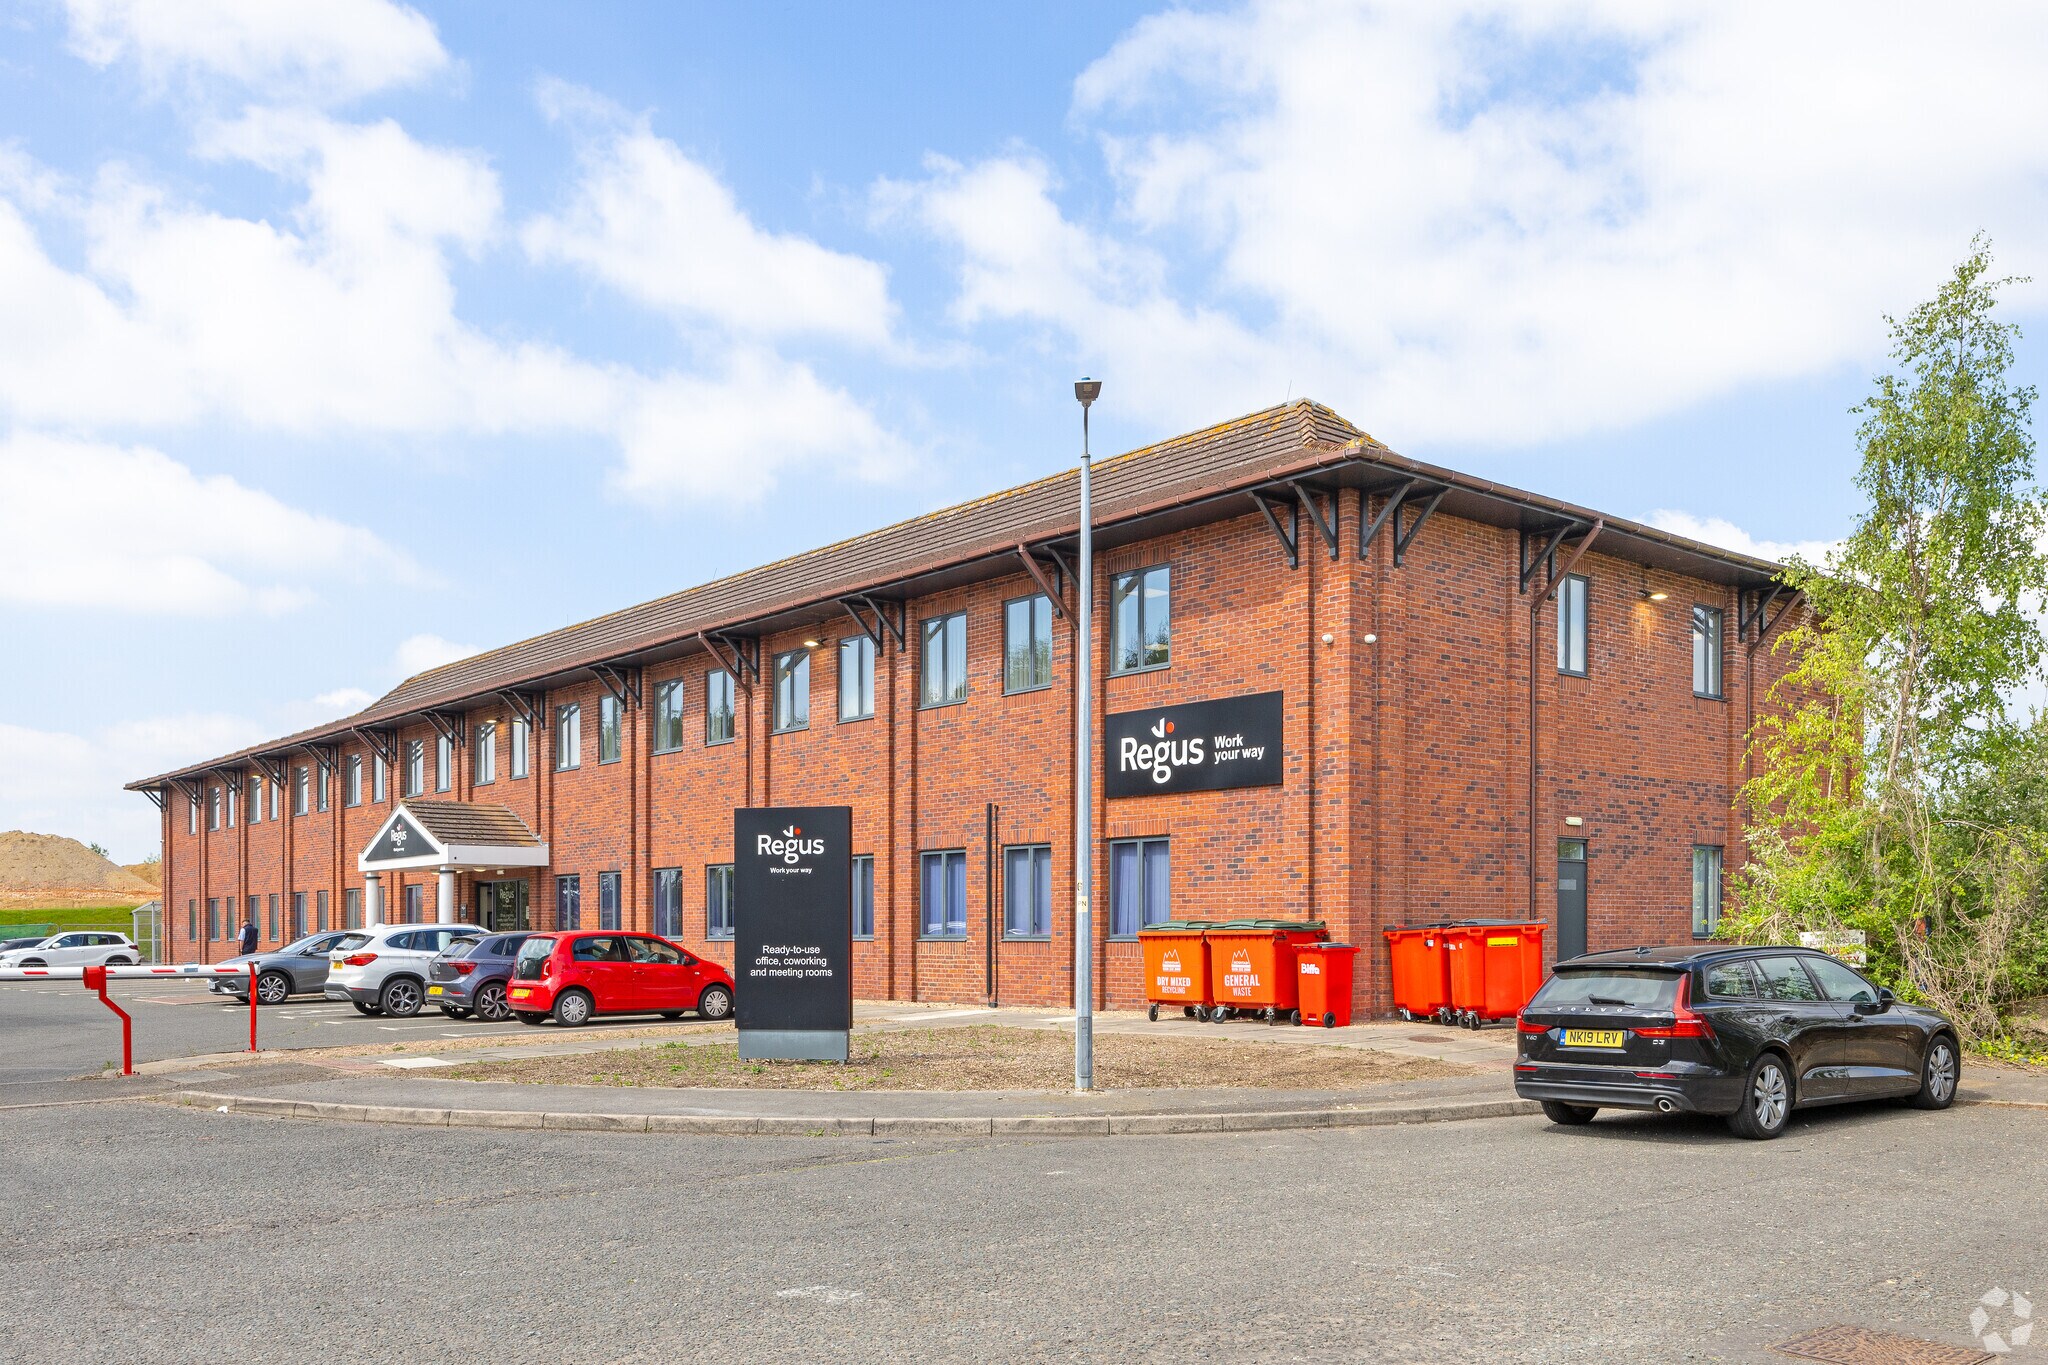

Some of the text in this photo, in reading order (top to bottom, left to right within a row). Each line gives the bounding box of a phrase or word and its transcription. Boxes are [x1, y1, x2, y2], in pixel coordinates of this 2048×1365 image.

[1214, 733, 1244, 749] Work
[1120, 736, 1205, 784] Regus
[1214, 746, 1265, 764] your way
[390, 829, 407, 846] Regus
[757, 834, 825, 865] Regus
[500, 888, 515, 903] Regus
[762, 945, 821, 955] Ready-to-use
[755, 956, 827, 966] office, coworking
[750, 968, 833, 978] and meeting rooms
[1300, 963, 1320, 974] Biffa
[1156, 976, 1191, 987] DRY MIXED
[1224, 974, 1260, 987] GENERAL
[1161, 986, 1186, 994] RECYCLING
[1232, 987, 1252, 996] WASTE
[1569, 1031, 1594, 1043] NK19
[1596, 1032, 1619, 1044] LRV
